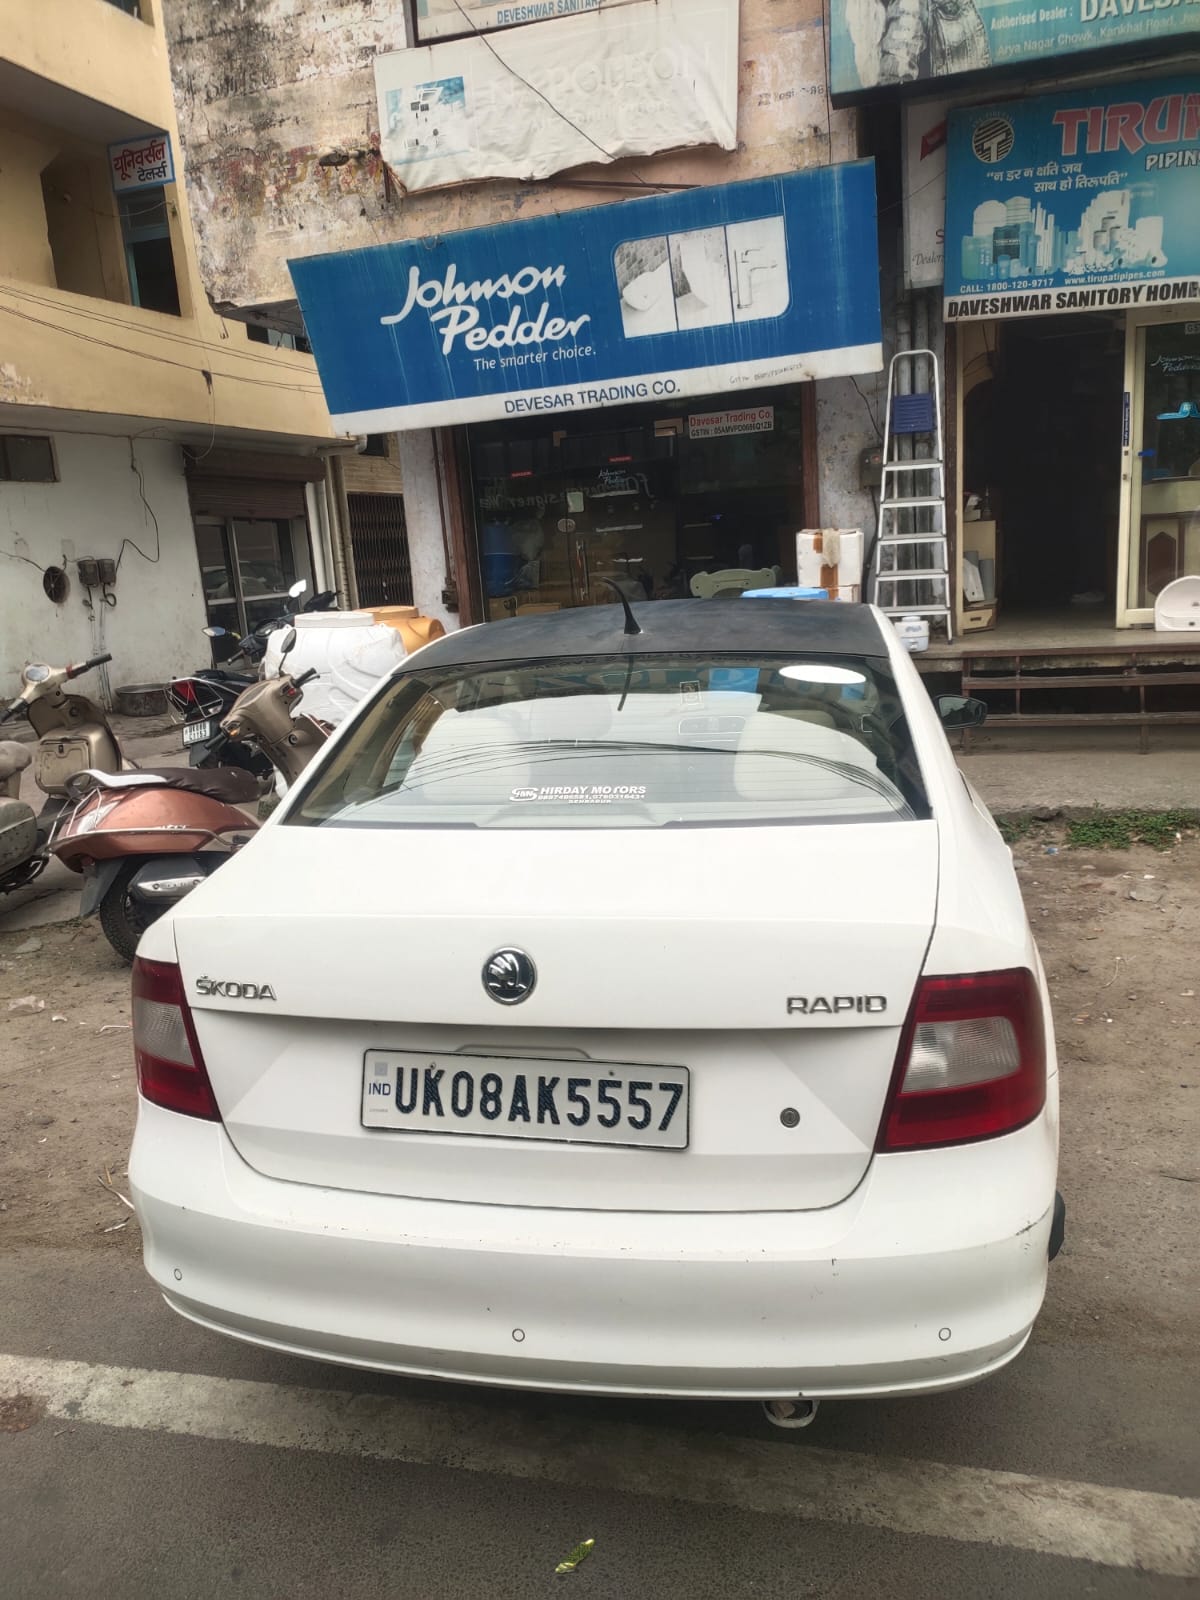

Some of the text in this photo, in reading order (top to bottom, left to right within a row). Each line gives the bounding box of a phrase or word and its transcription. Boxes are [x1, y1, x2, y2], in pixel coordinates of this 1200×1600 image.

[497, 3, 555, 25] DEVESHWAR
[991, 13, 1037, 31] Authorised
[1039, 7, 1067, 22] Dealer
[1024, 37, 1055, 53] Nagar
[113, 140, 166, 181] यूनिवर्सल
[137, 161, 167, 181] टेलर्स
[1006, 170, 1021, 182] डर
[1023, 167, 1034, 178] न
[1036, 160, 1058, 177] क्षति
[1145, 150, 1200, 171] PIPIN
[1059, 176, 1072, 192] हो
[960, 268, 1167, 295] CALL: 1800-120-9717 www.tirupatipipes.com
[380, 263, 567, 326] Johnson
[947, 296, 1052, 319] DAVESHWAR
[1056, 284, 1146, 309] SANITORY
[430, 302, 591, 356] Pedder
[474, 344, 597, 371] The smarter choice.
[504, 379, 681, 413] DEVESAR TRADING CO.
[725, 410, 757, 423] Trading
[758, 409, 773, 420] Co.
[540, 786, 589, 794] HIRDAY
[786, 995, 888, 1015] RAPID
[368, 1066, 685, 1132] IND UK08AK5557
